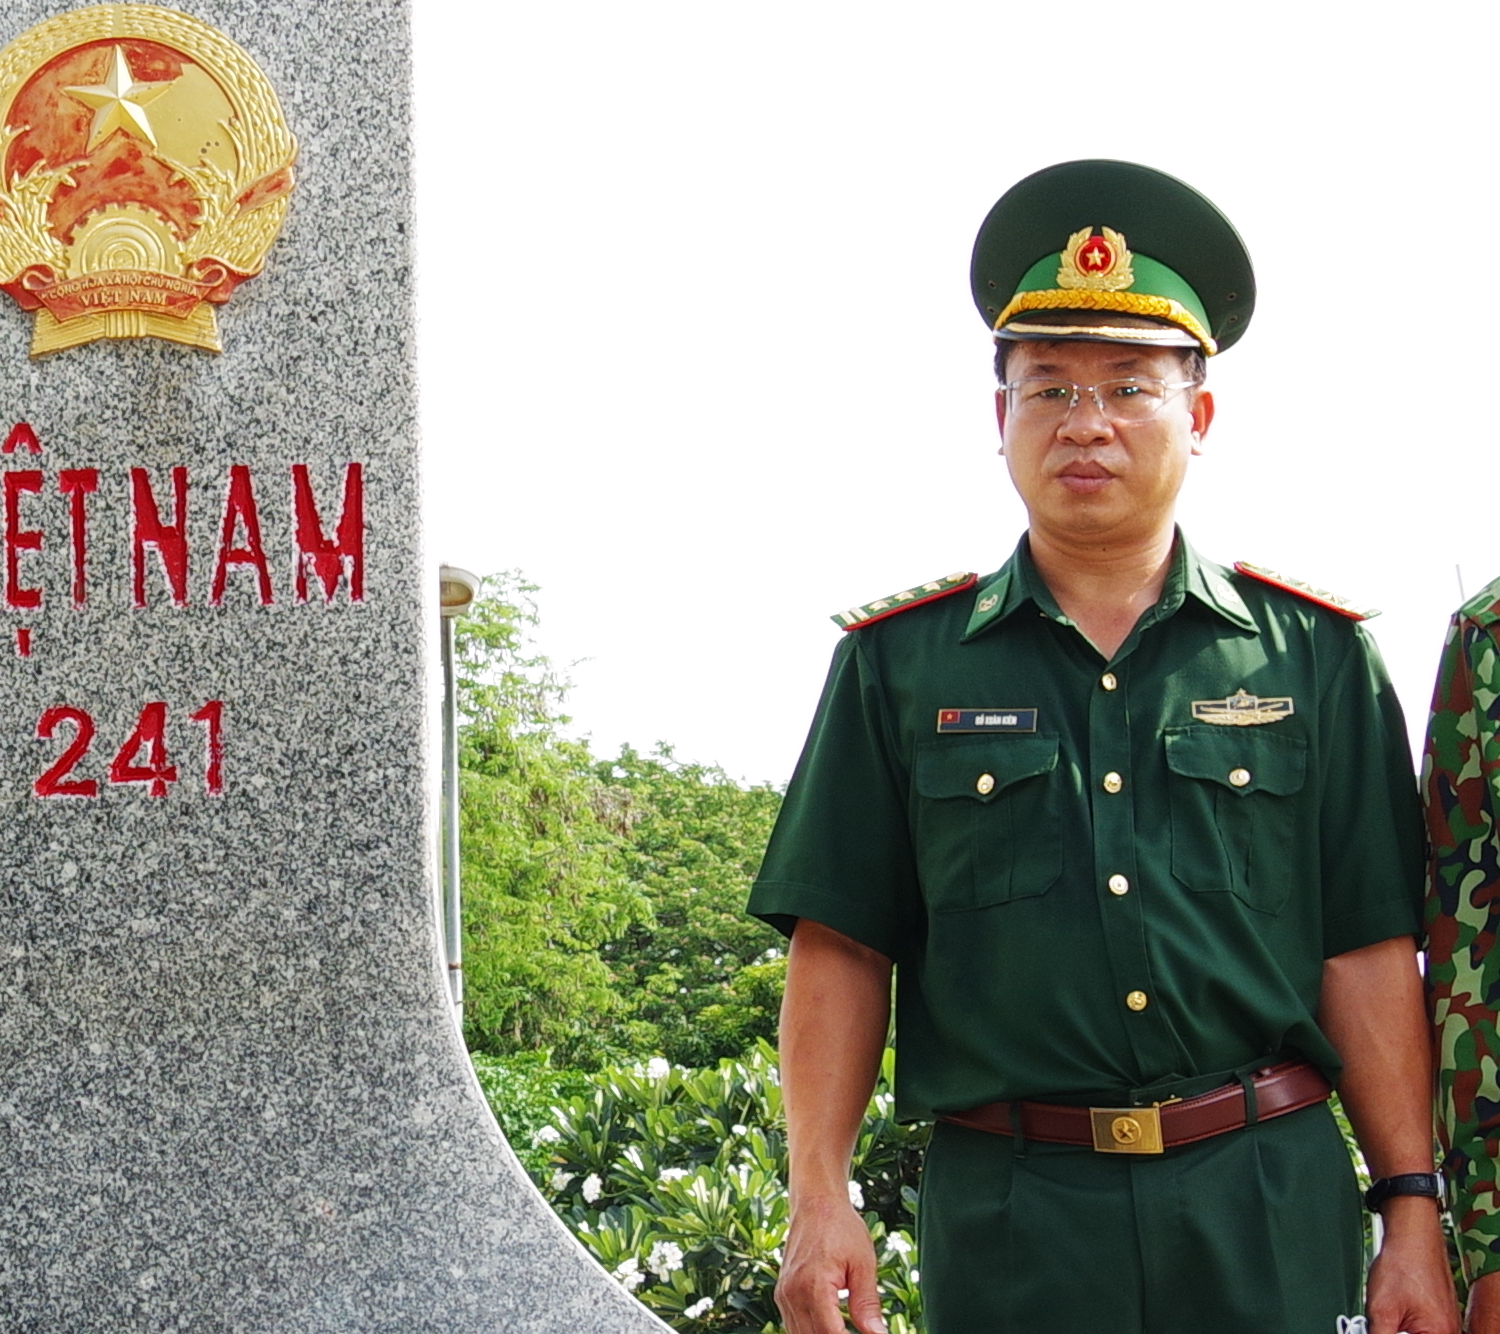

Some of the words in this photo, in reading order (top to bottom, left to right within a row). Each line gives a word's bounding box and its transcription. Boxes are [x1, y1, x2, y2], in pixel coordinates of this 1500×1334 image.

[80, 287, 122, 306] VIỆT
[128, 289, 168, 305] NAM
[129, 462, 365, 608] NAM
[34, 699, 224, 798] 241
